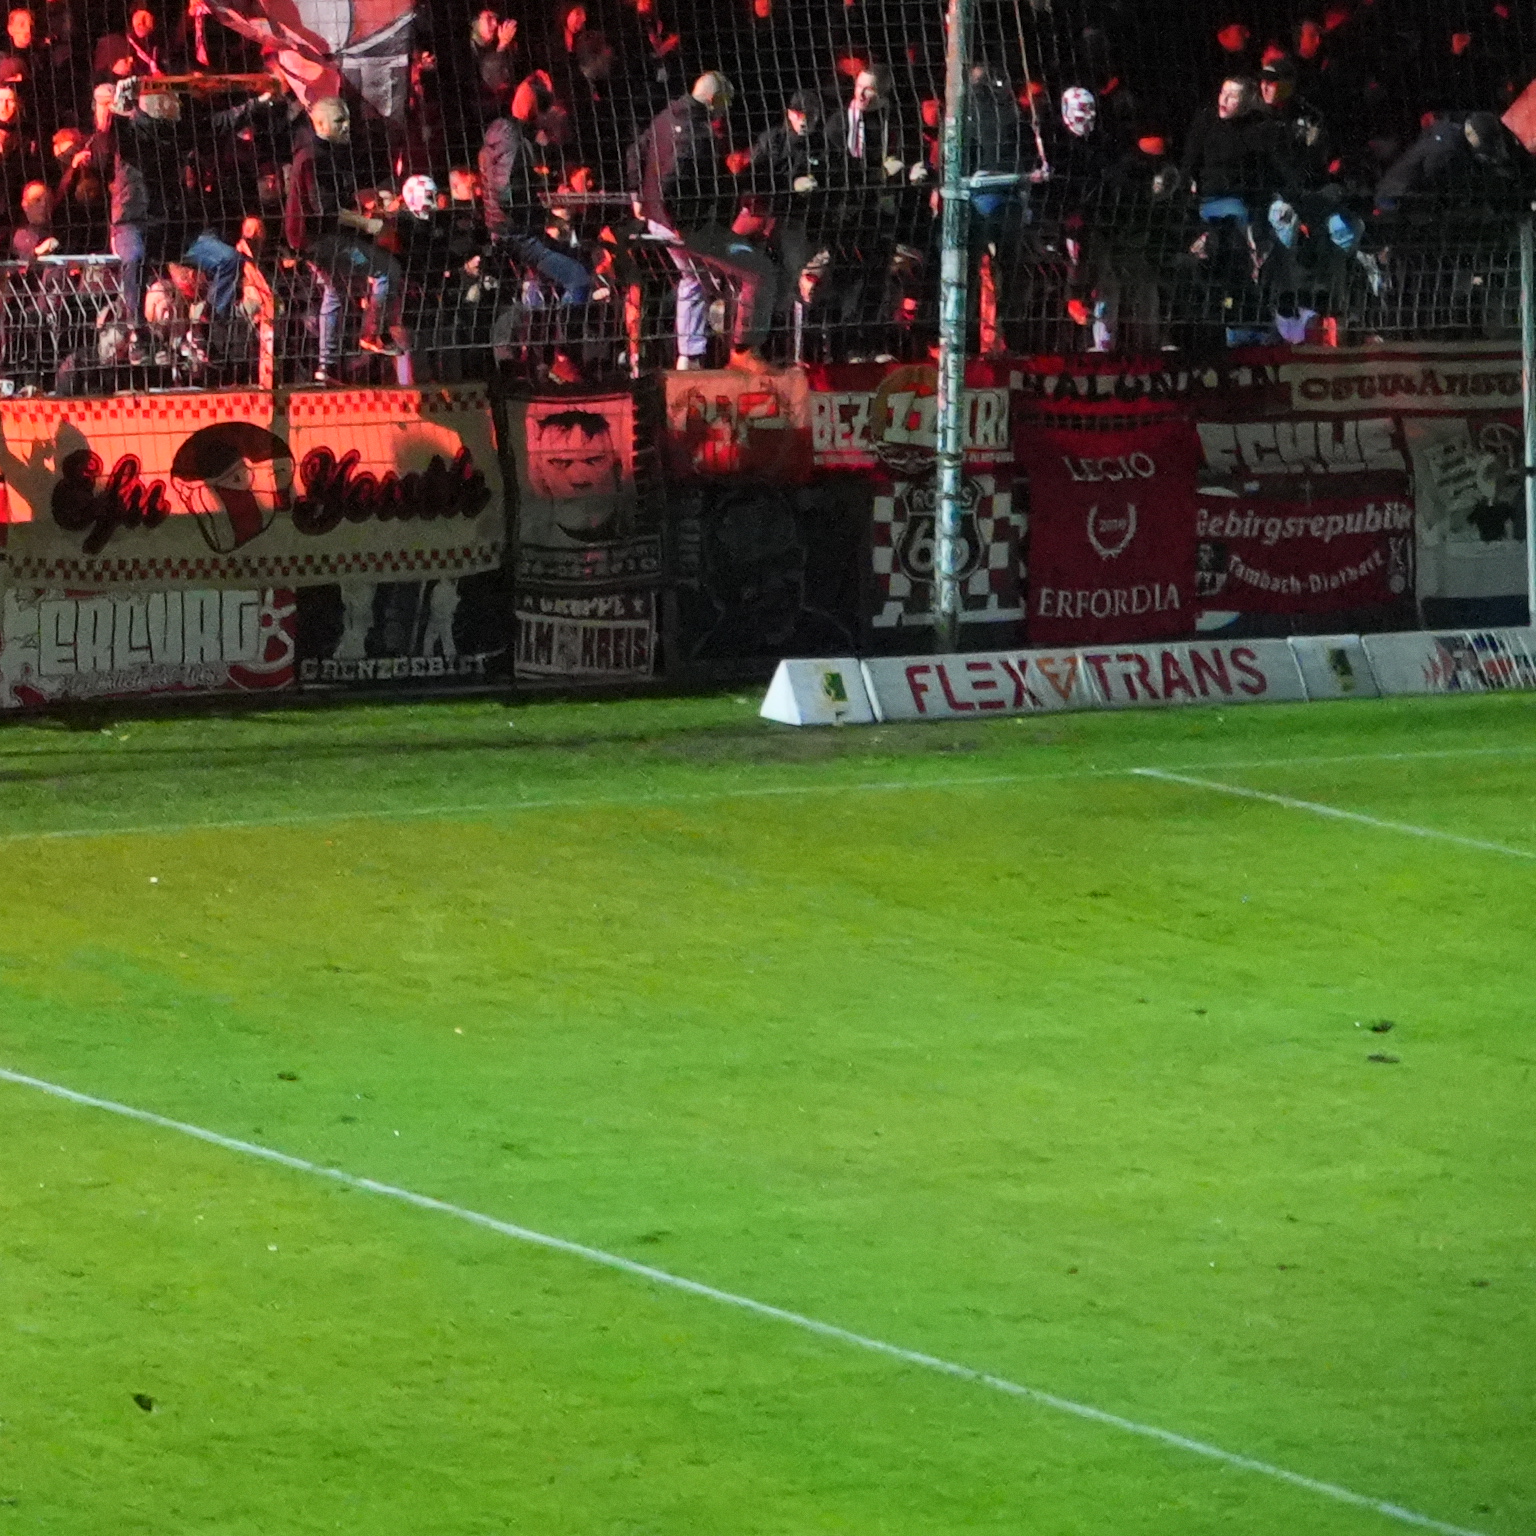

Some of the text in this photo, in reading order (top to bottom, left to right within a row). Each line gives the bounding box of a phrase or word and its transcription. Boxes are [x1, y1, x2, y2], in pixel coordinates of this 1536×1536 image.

[1196, 501, 1411, 546] Gebirgsrepublik
[1038, 583, 1181, 620] ERFORDIA
[904, 646, 1269, 715] FLEX TRANS
